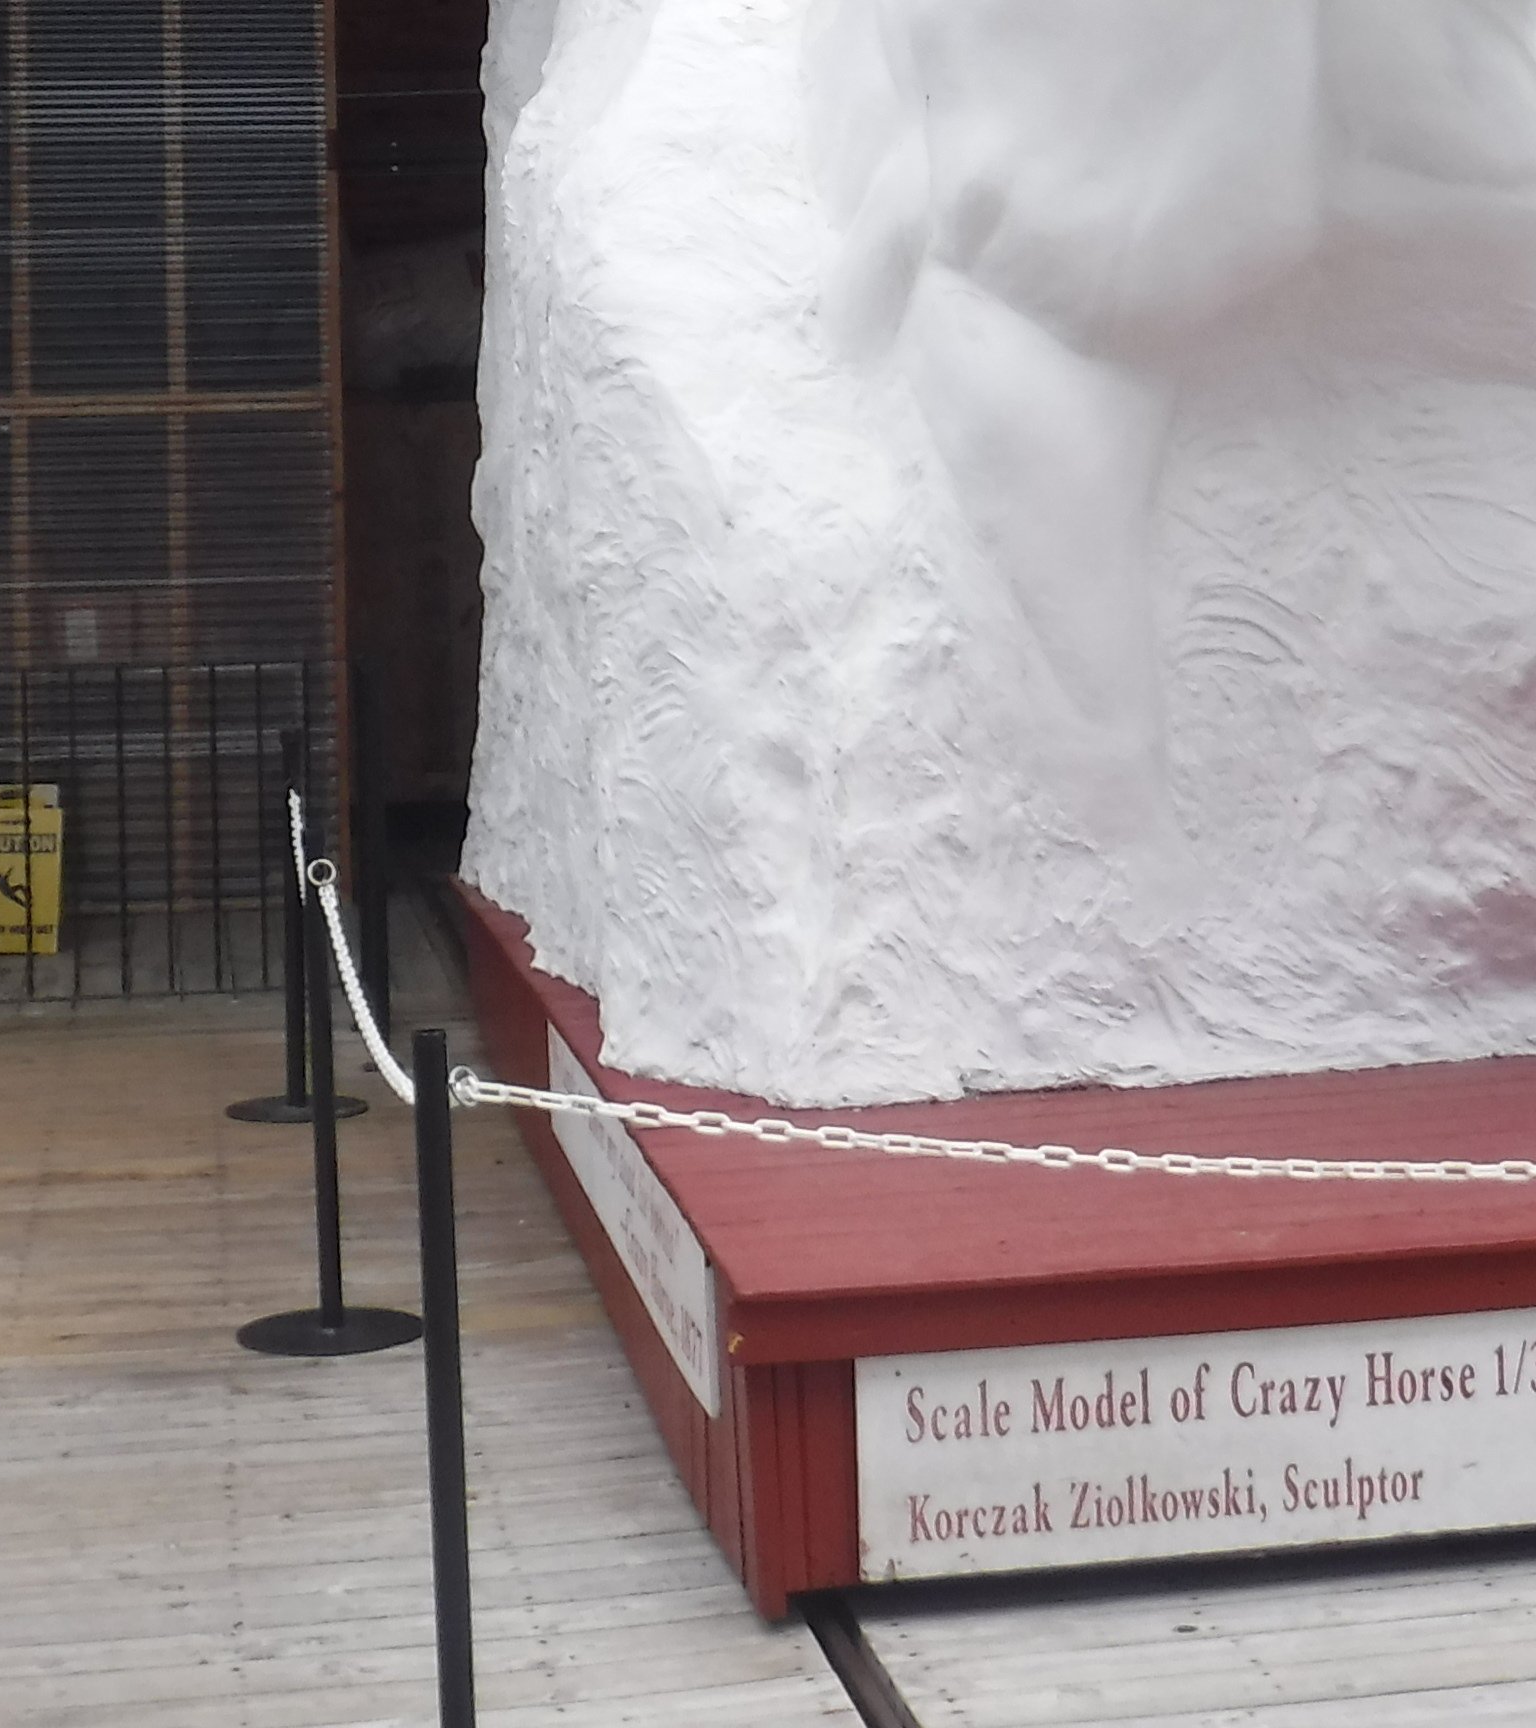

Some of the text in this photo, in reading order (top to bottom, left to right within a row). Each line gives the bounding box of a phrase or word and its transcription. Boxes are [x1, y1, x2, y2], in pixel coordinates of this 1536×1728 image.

[904, 1379, 1012, 1444] Scale
[1029, 1367, 1152, 1435] Model
[1170, 1362, 1211, 1424] of
[1229, 1360, 1347, 1428] Crazy
[1363, 1350, 1476, 1409] Horse
[908, 1456, 1425, 1545] Korczak Ziolkowski, Sculptor
